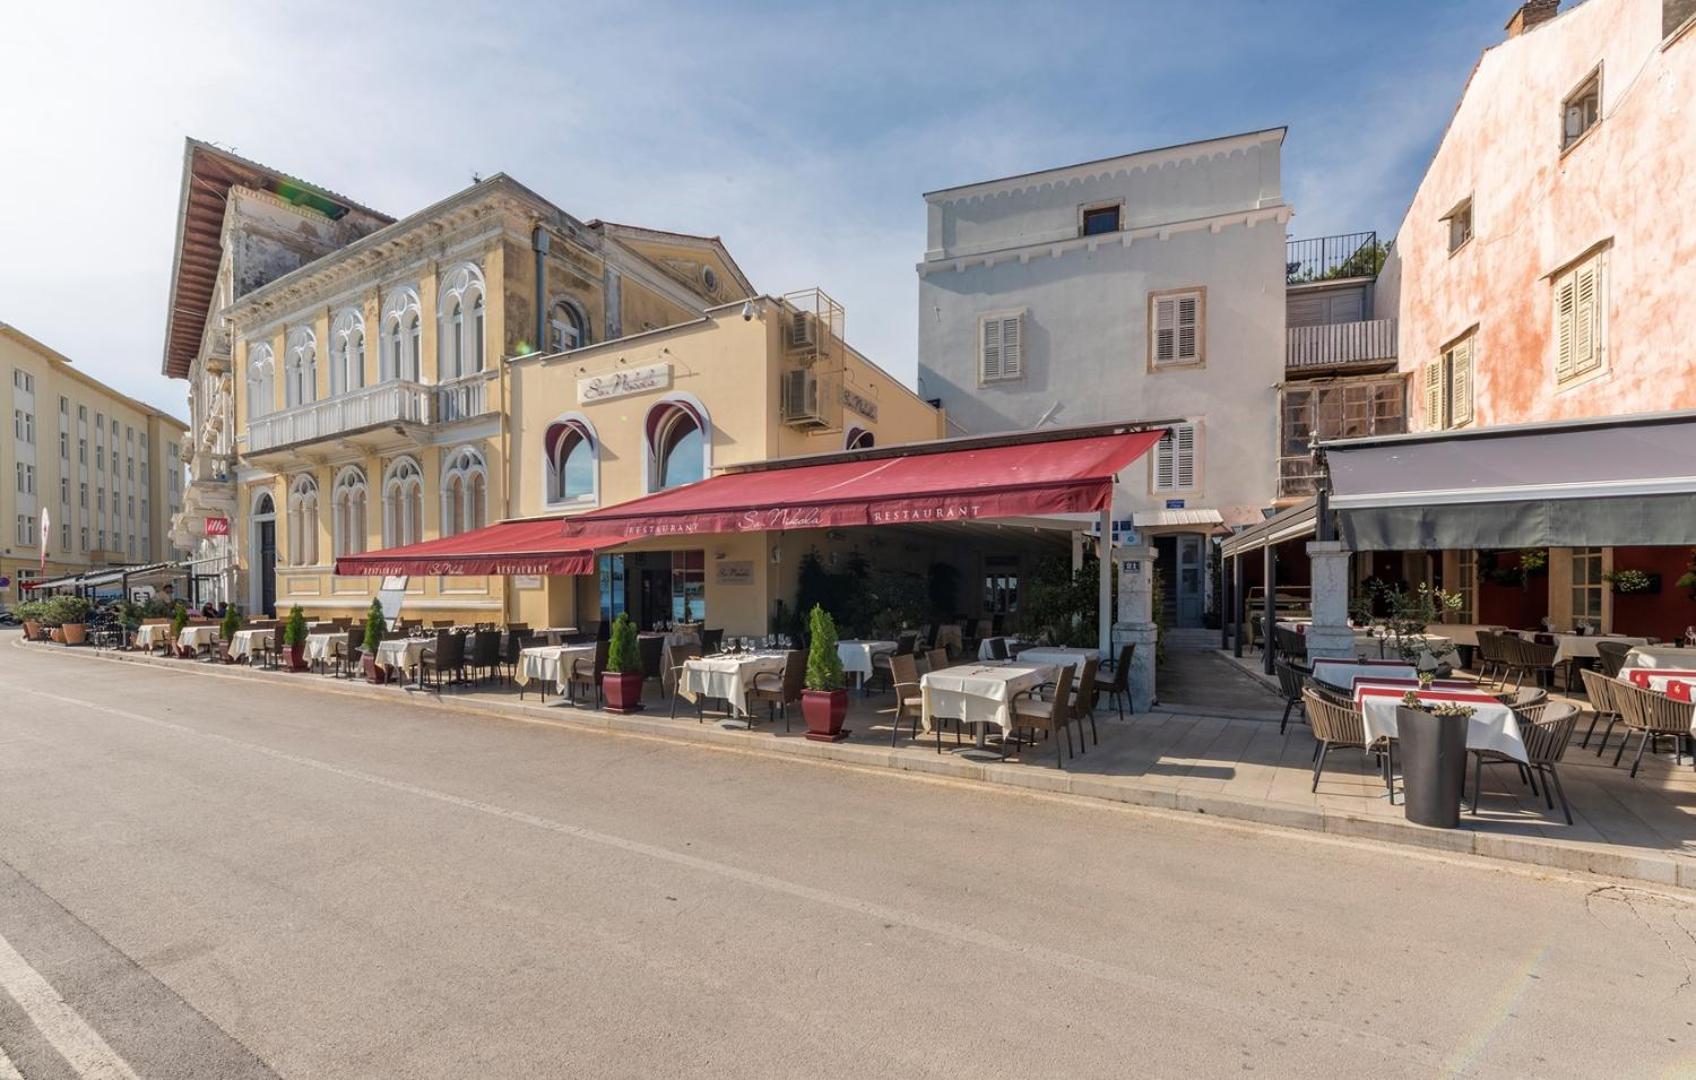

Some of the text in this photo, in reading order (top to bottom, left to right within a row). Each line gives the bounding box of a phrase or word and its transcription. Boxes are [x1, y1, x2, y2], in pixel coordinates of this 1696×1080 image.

[627, 522, 699, 537] RESTAURANT
[874, 505, 980, 521] RESTAURANT
[496, 564, 549, 575] RESTAURANT
